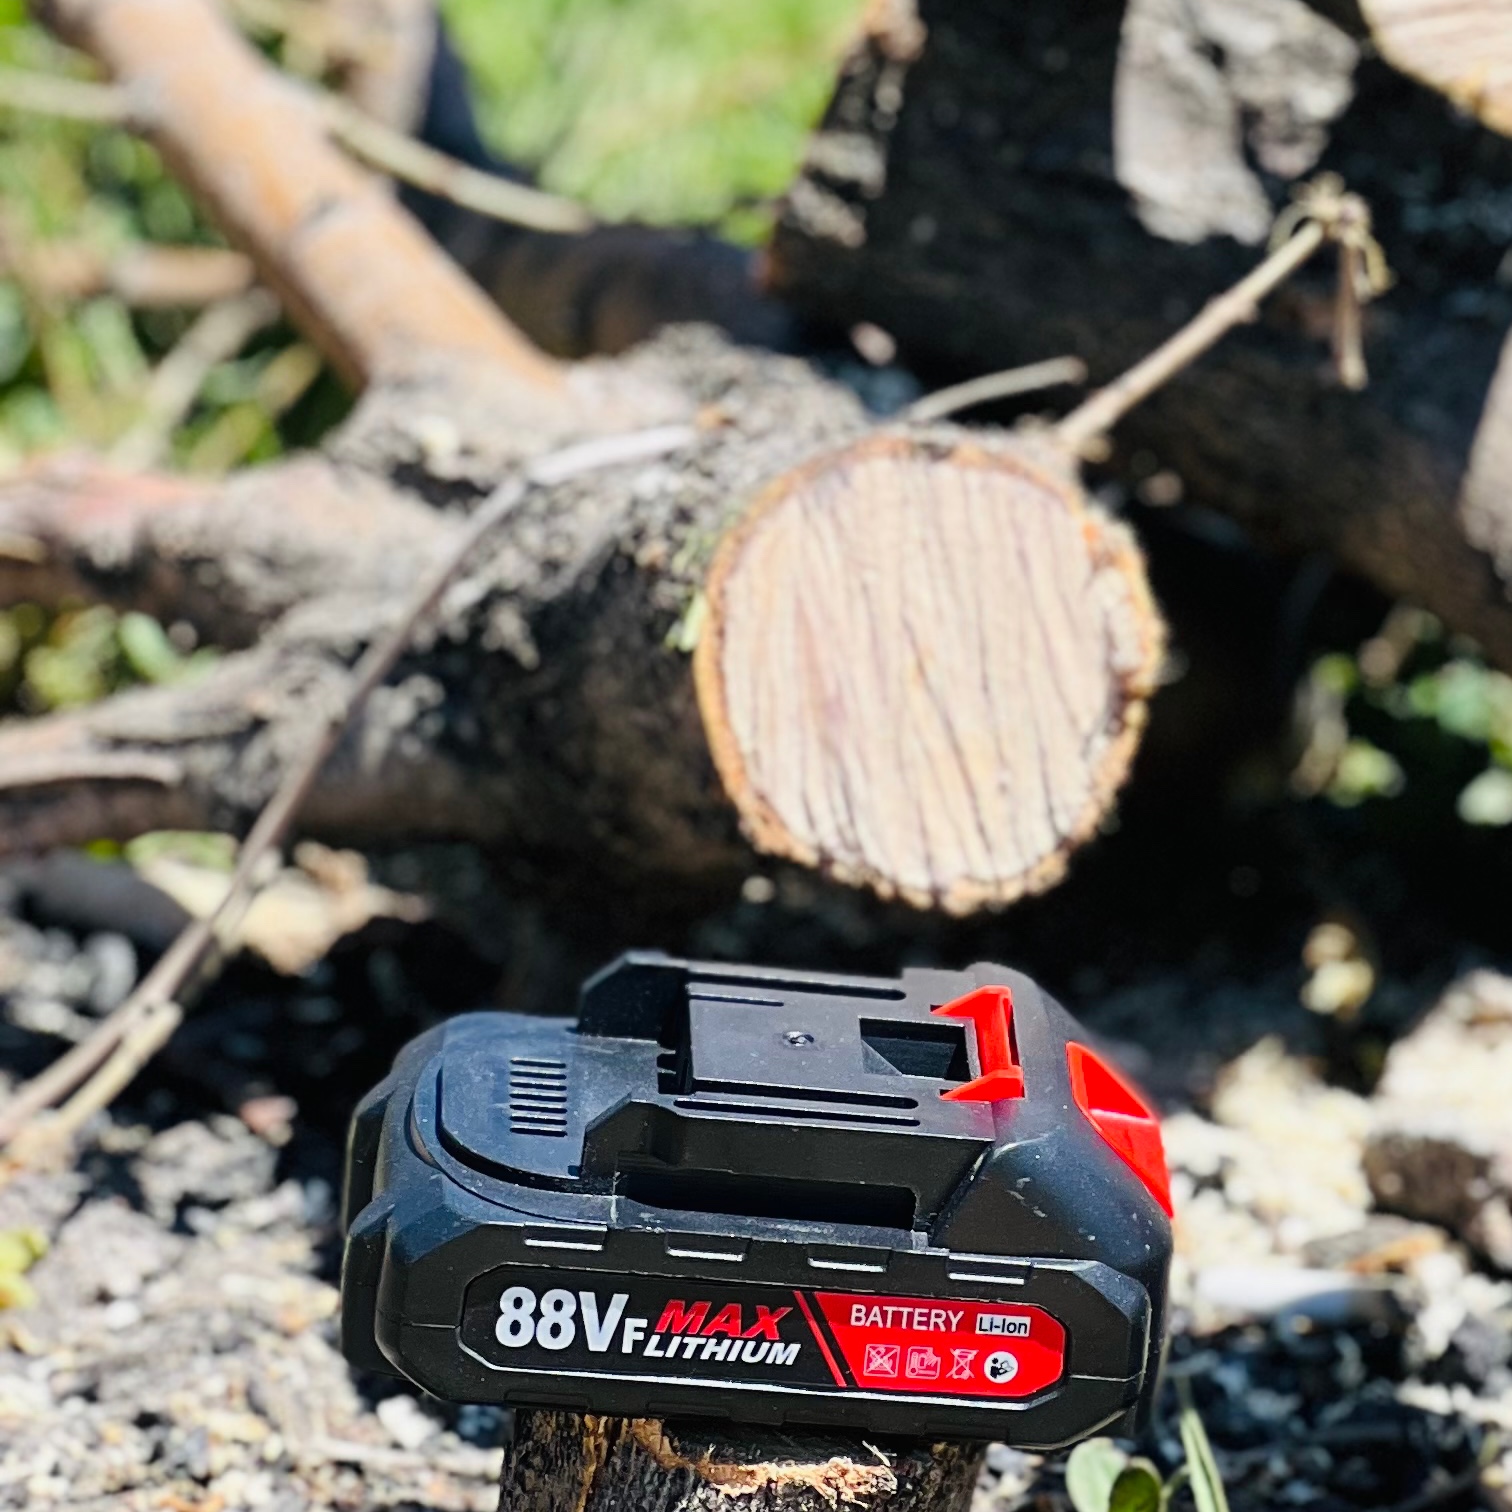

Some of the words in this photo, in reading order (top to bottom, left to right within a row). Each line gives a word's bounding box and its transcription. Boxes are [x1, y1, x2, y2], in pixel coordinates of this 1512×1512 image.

[654, 1299, 794, 1340] MAX
[850, 1303, 965, 1333] BATTERY
[643, 1334, 801, 1366] LITHIUM
